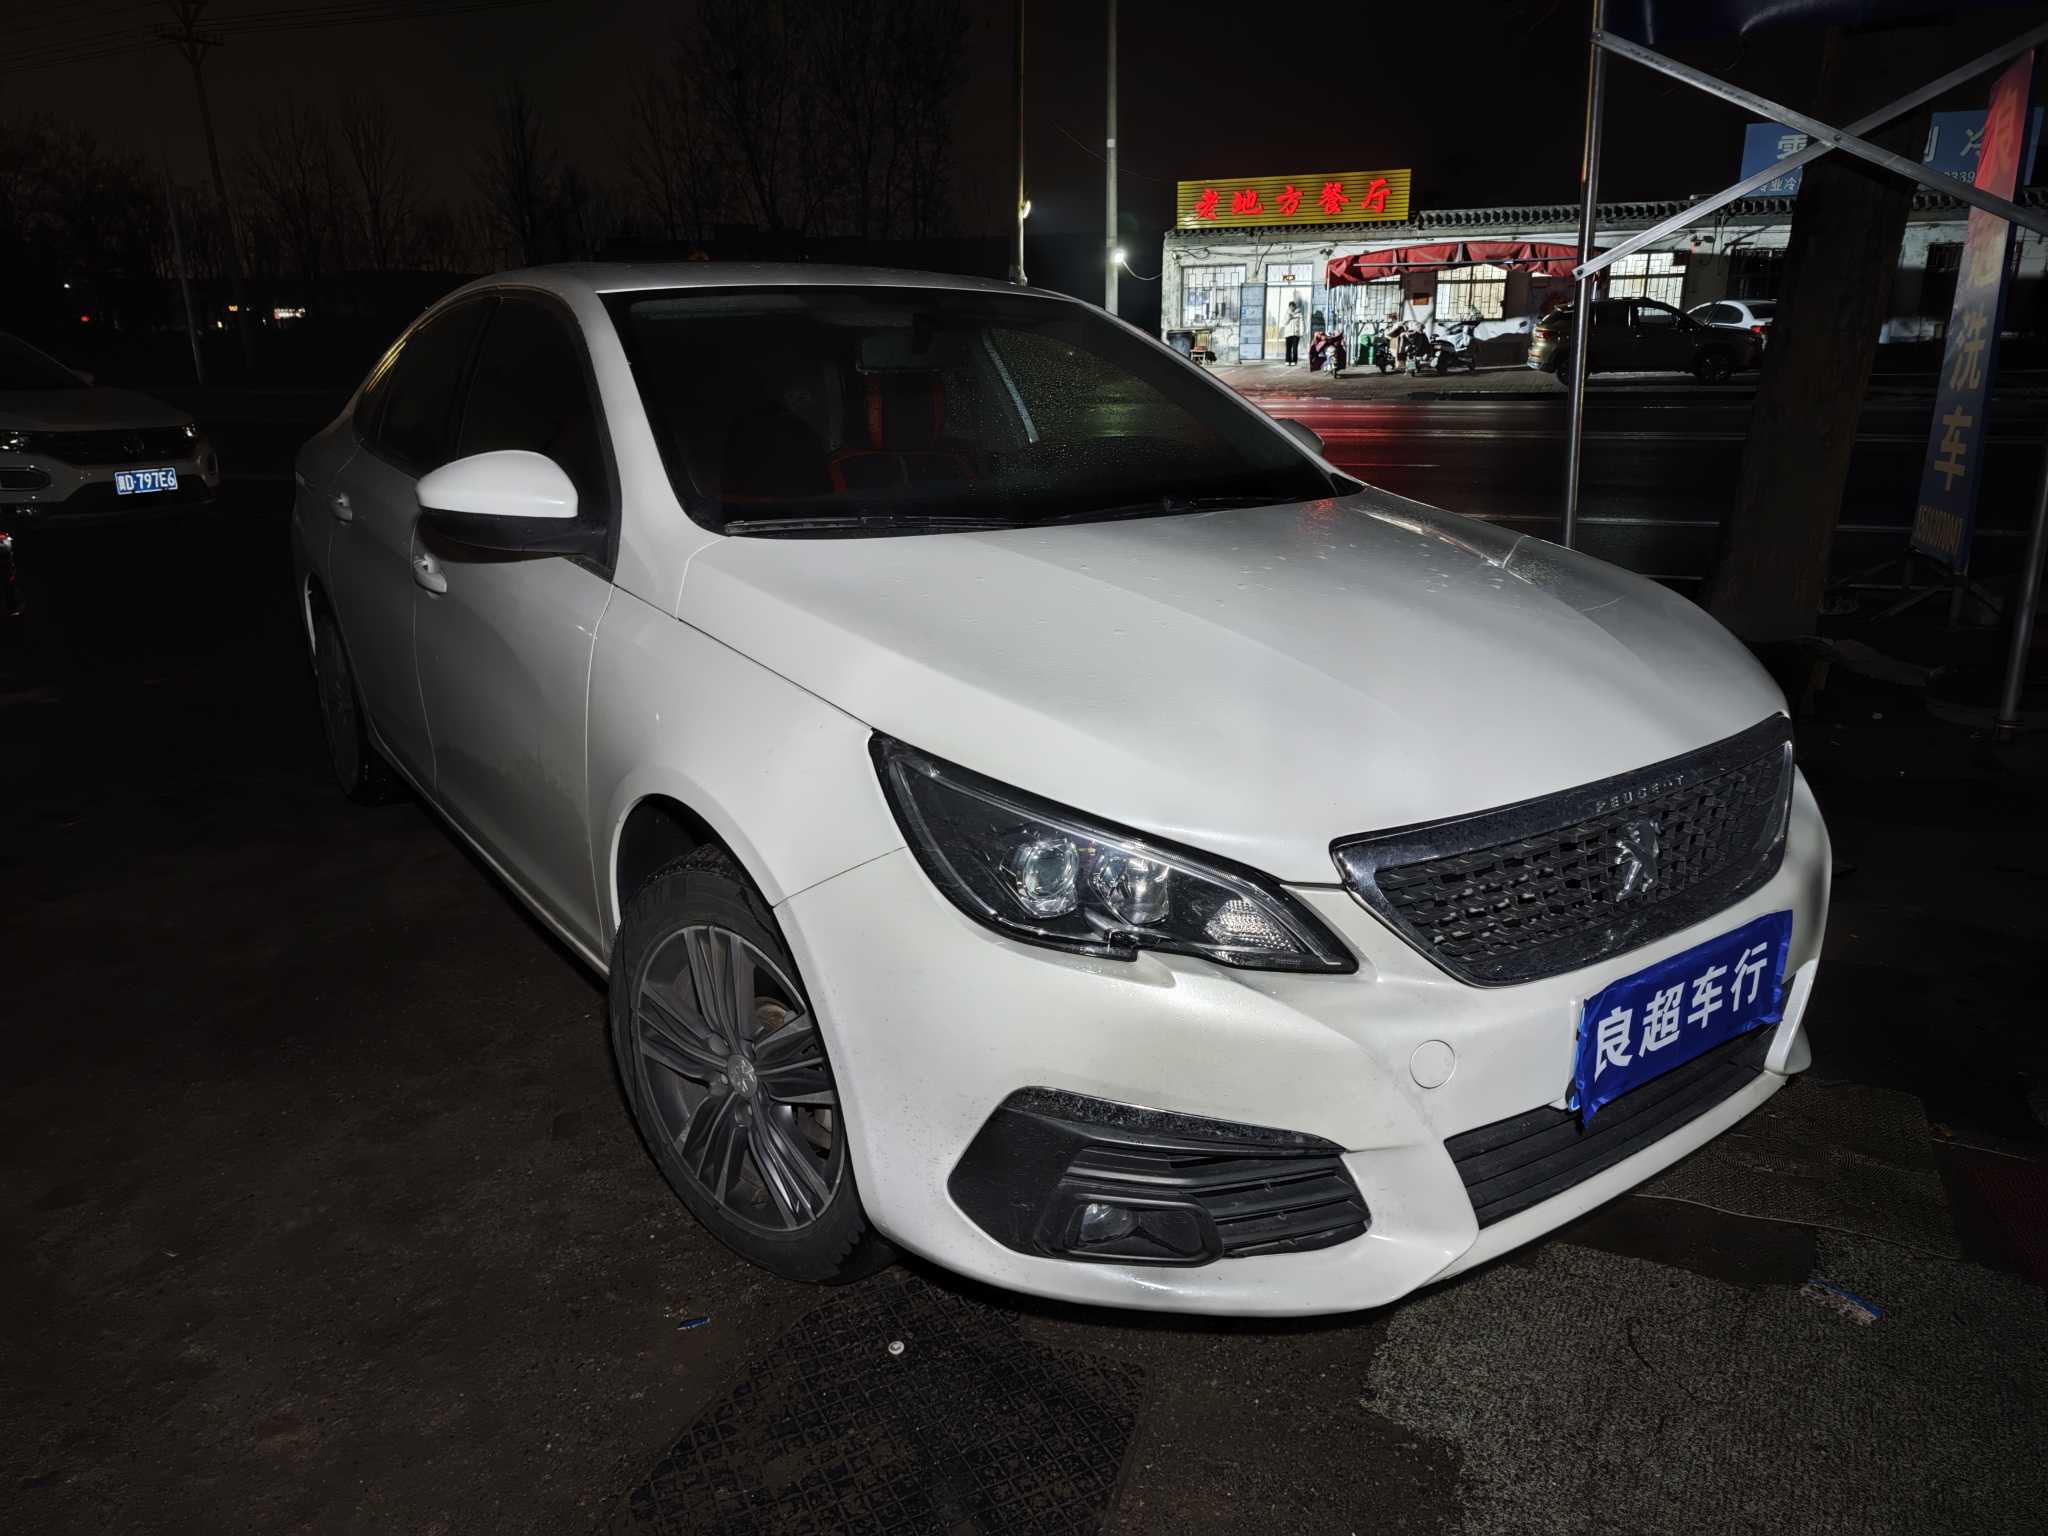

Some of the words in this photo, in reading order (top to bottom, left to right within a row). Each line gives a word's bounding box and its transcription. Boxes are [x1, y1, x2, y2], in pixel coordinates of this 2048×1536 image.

[1194, 177, 1392, 221] 老地方餐厅
[1594, 941, 1768, 1082] 良超车行
